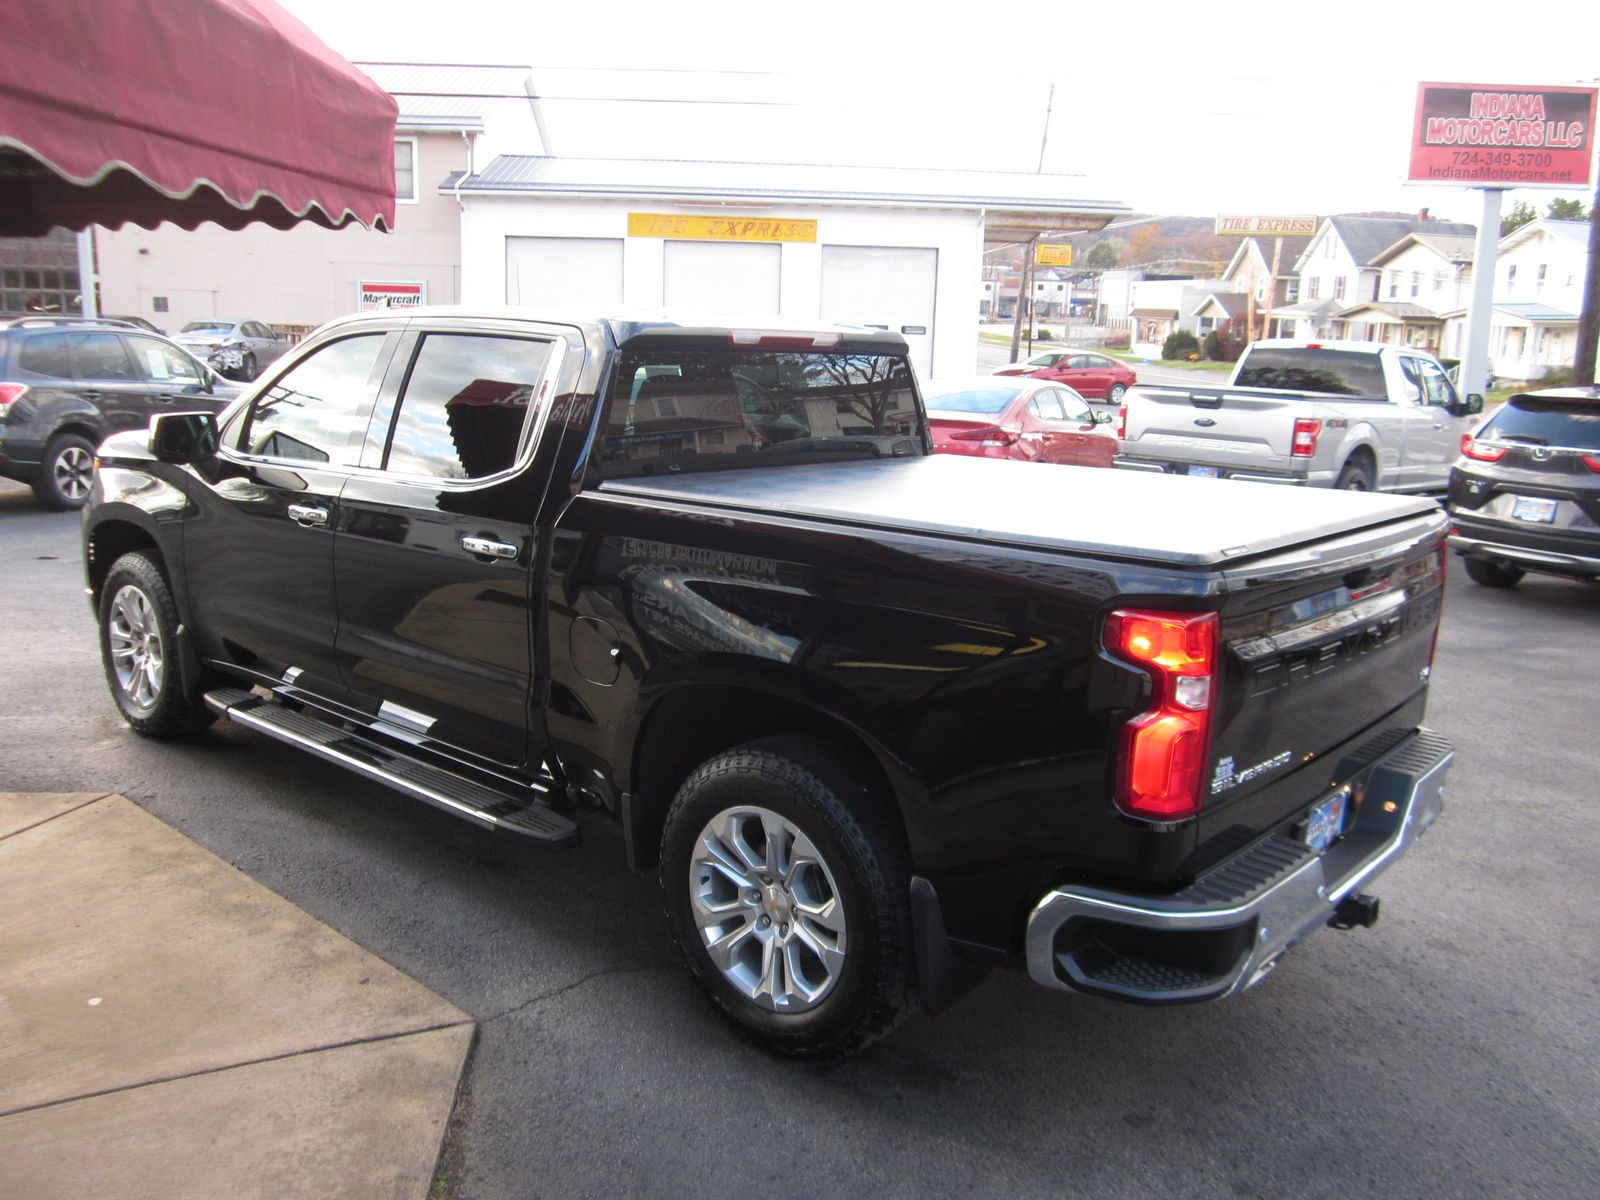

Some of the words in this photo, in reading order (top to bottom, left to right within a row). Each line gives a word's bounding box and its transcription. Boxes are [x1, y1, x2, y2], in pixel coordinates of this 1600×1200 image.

[1470, 92, 1545, 120] INDIANA
[1426, 117, 1544, 146] MOTORCARS
[1545, 121, 1583, 148] LLC
[1452, 151, 1553, 168] 724-349-3700
[1429, 165, 1573, 182] IndianaMotorcars.net
[1222, 217, 1251, 230] TIRE
[1256, 218, 1313, 232] EXPRESS
